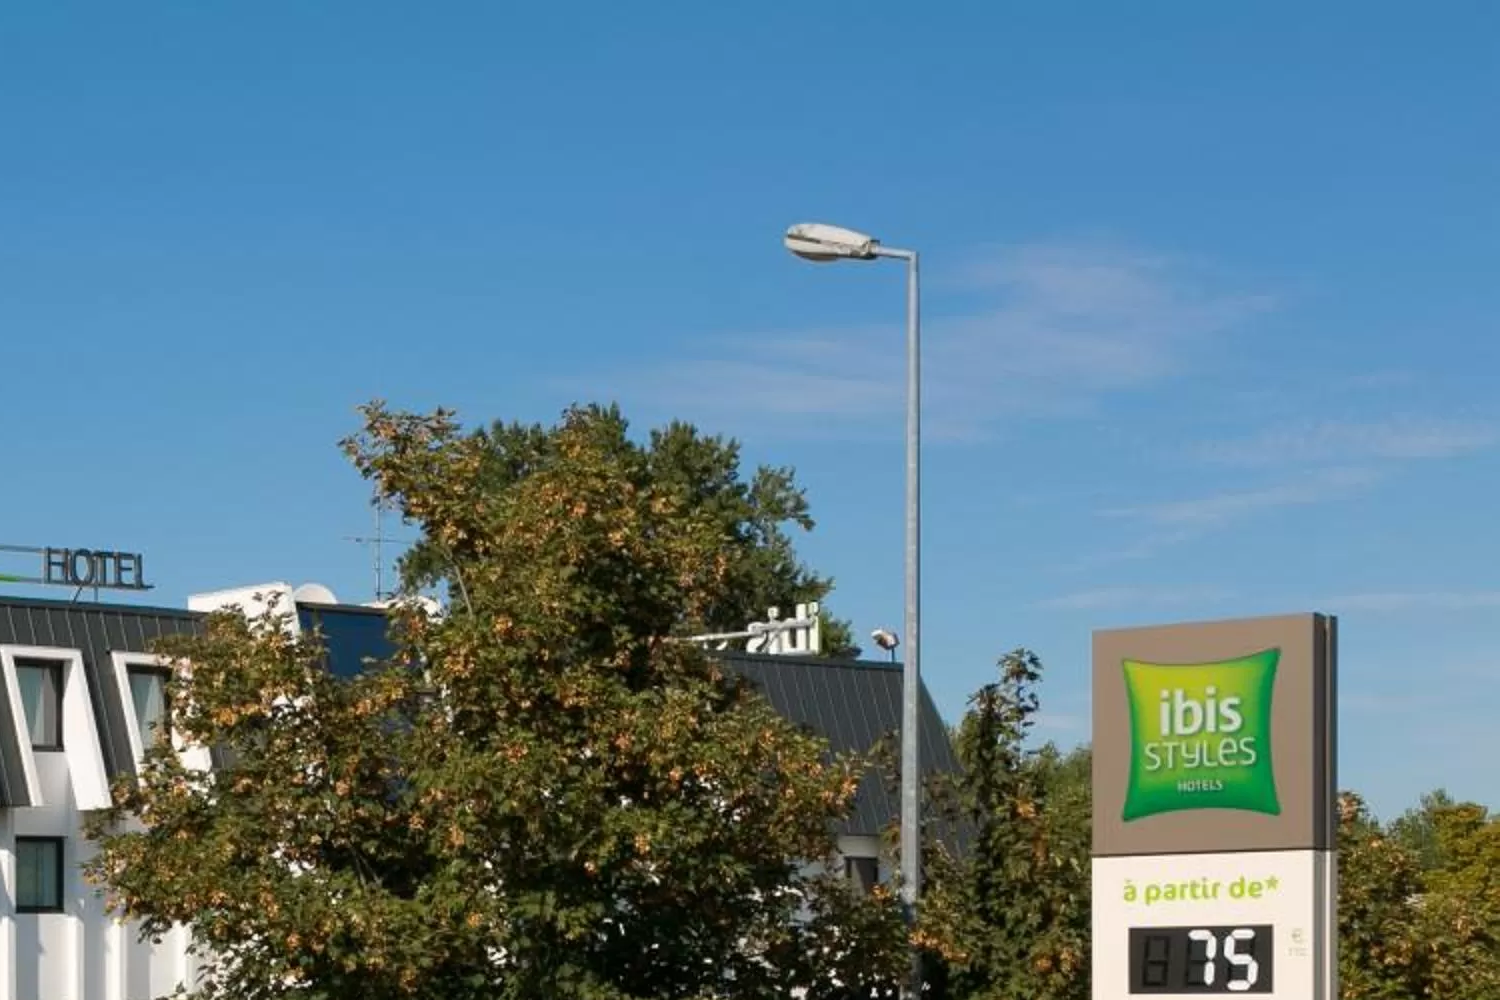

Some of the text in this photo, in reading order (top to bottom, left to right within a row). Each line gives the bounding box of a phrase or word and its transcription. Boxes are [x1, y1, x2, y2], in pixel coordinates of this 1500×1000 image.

[43, 546, 155, 590] HOTEL
[1159, 685, 1243, 737] ibis
[1176, 779, 1224, 793] HOTELS
[1123, 879, 1137, 903] à
[1144, 877, 1221, 905] partir
[1187, 928, 1260, 992] 75
